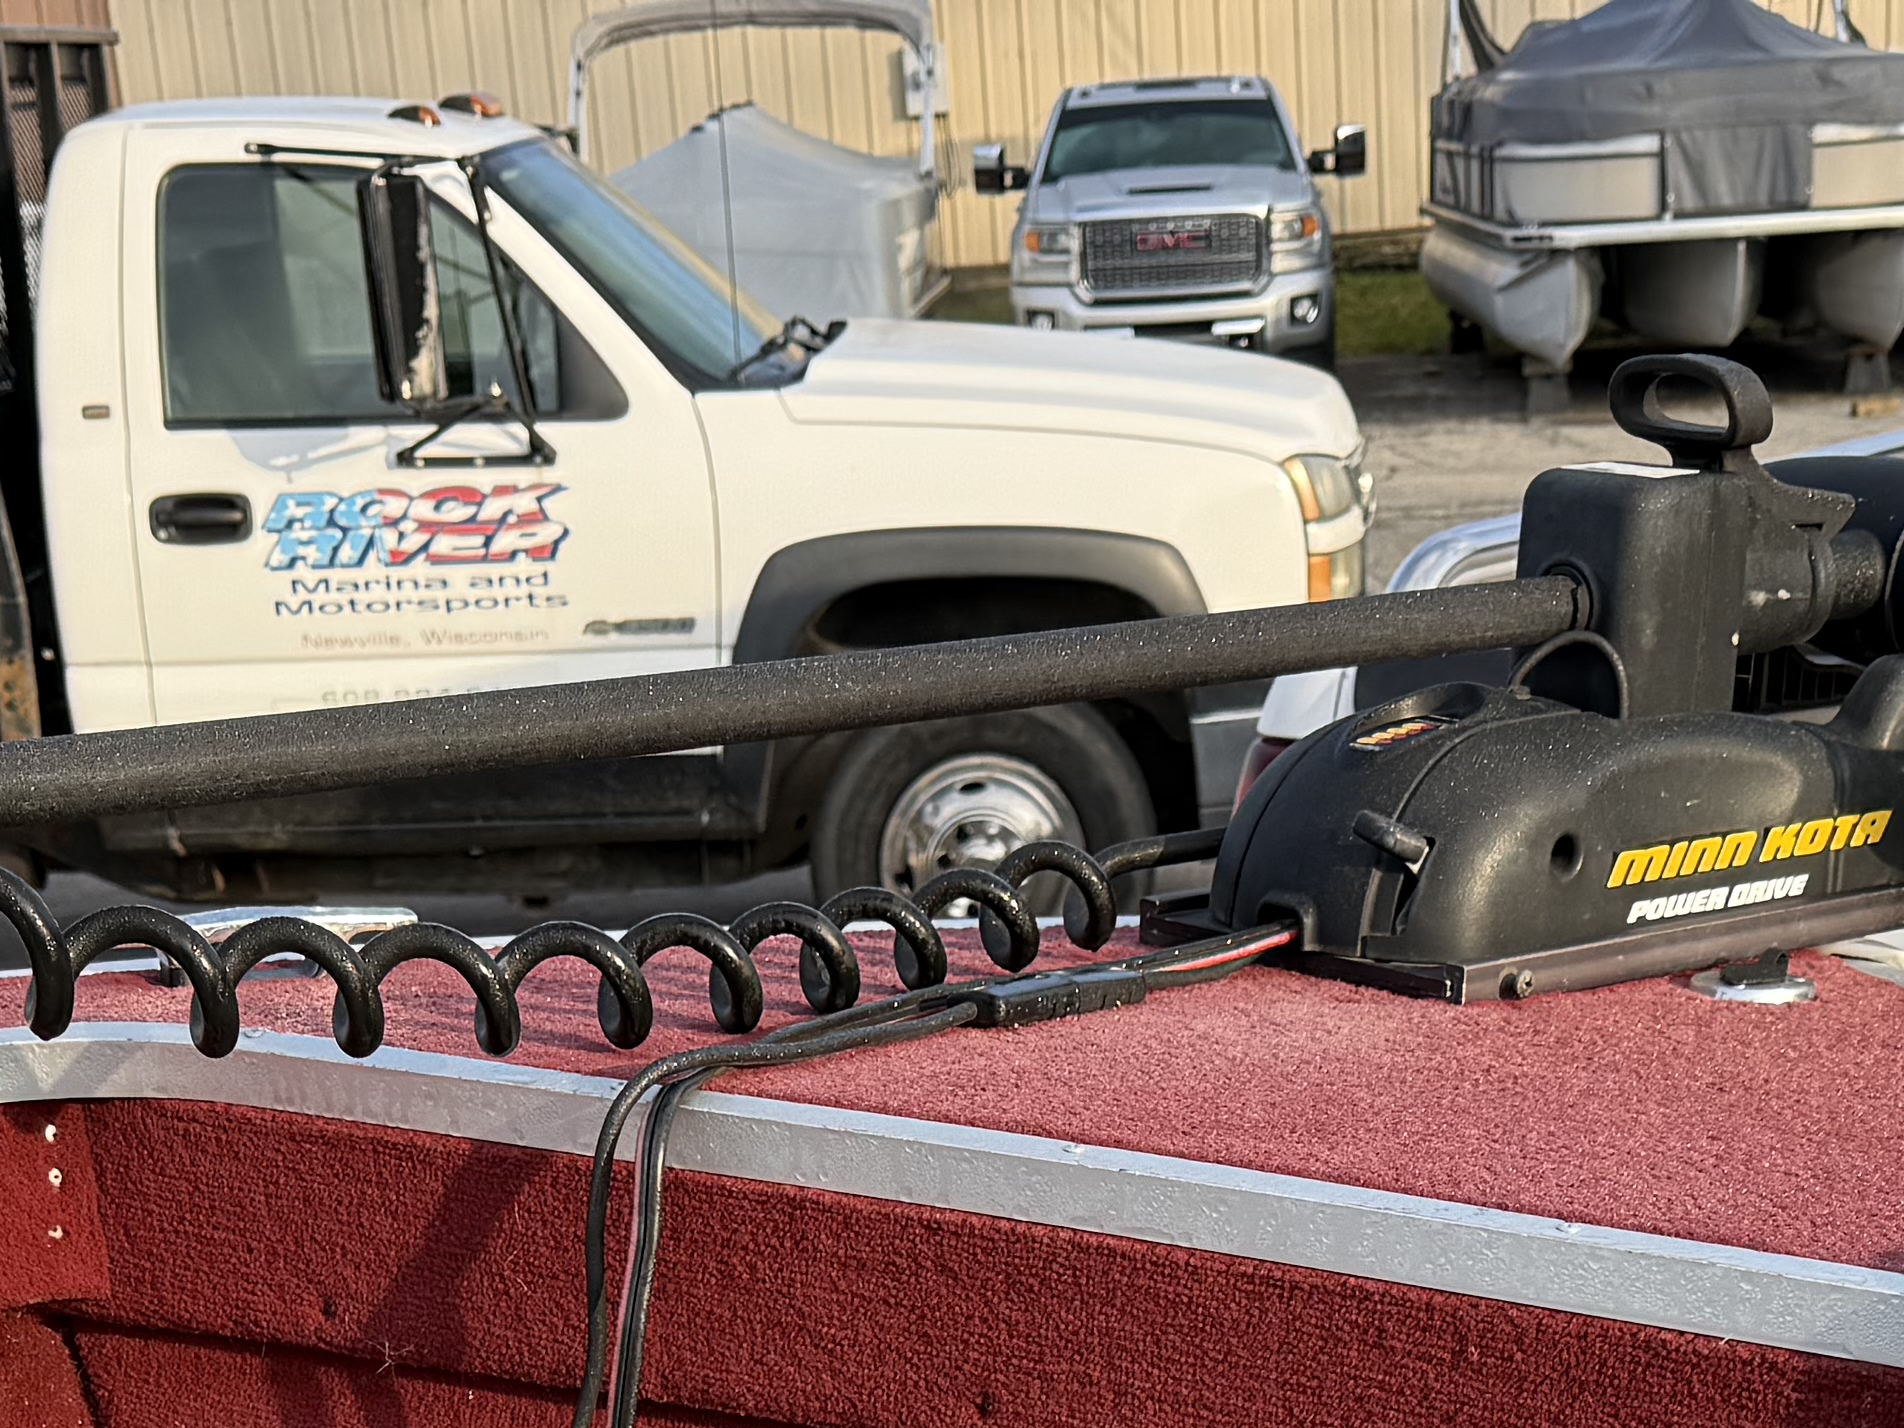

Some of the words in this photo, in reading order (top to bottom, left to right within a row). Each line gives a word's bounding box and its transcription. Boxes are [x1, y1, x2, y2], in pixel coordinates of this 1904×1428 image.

[262, 483, 569, 533] ROCK
[264, 520, 569, 571] RIVER
[274, 592, 569, 616] Motorsports
[291, 574, 449, 594] Marina
[469, 570, 550, 588] and
[1606, 831, 1759, 889] MINN
[1759, 809, 1894, 863] KOTA
[1626, 887, 1730, 925] POWER
[1727, 874, 1810, 908] DRIVE
